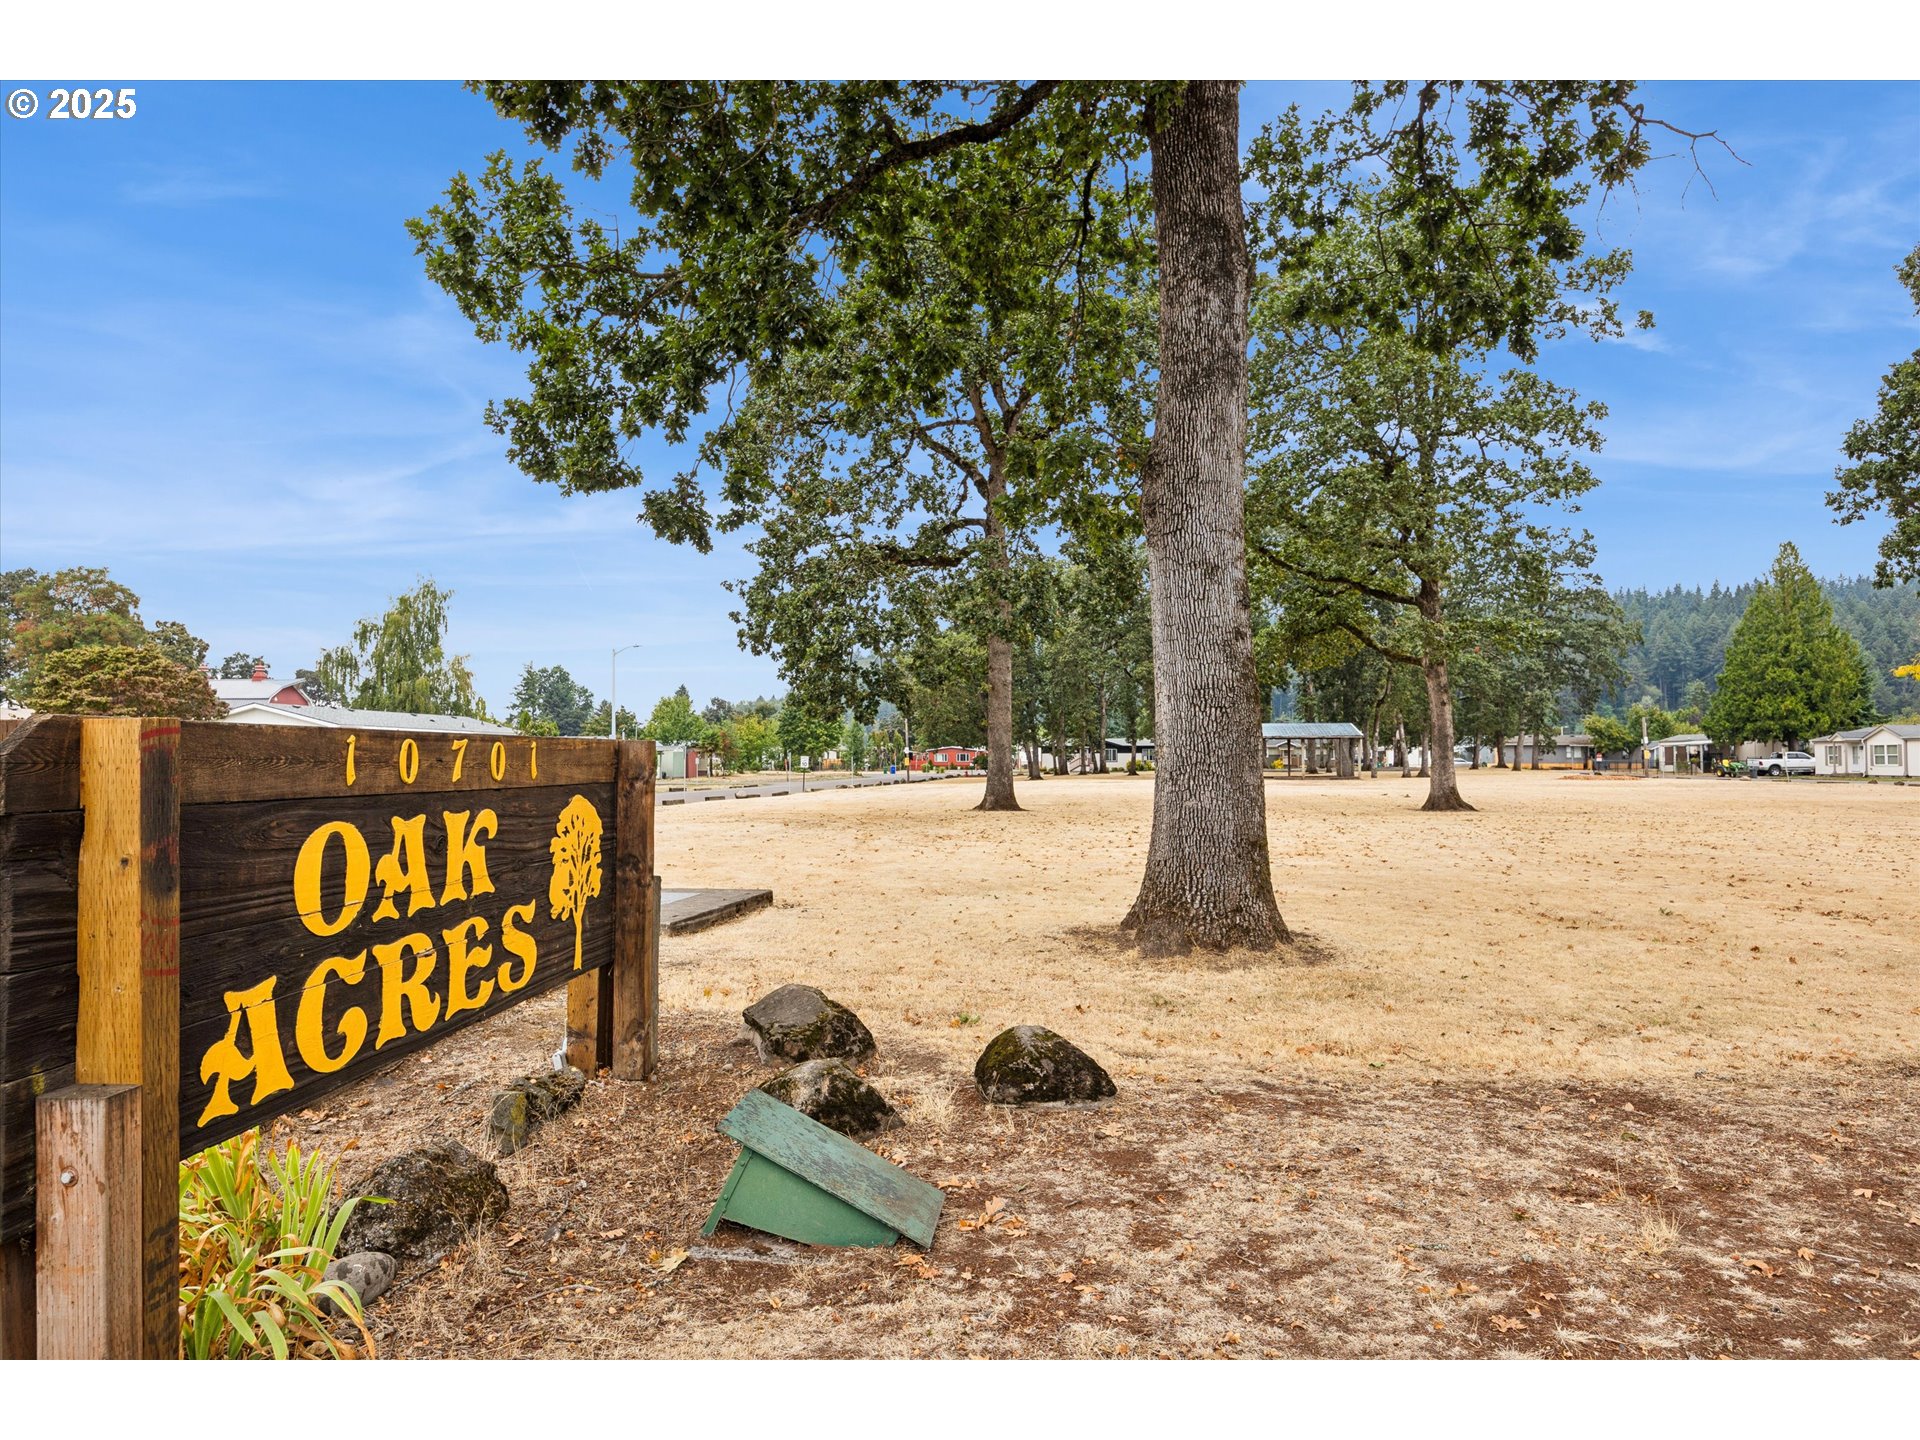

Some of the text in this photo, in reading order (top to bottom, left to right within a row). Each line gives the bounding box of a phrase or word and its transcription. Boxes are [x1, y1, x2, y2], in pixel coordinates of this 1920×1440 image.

[345, 735, 540, 787] 10701
[293, 808, 498, 938] OAK
[196, 898, 539, 1128] ACRES
